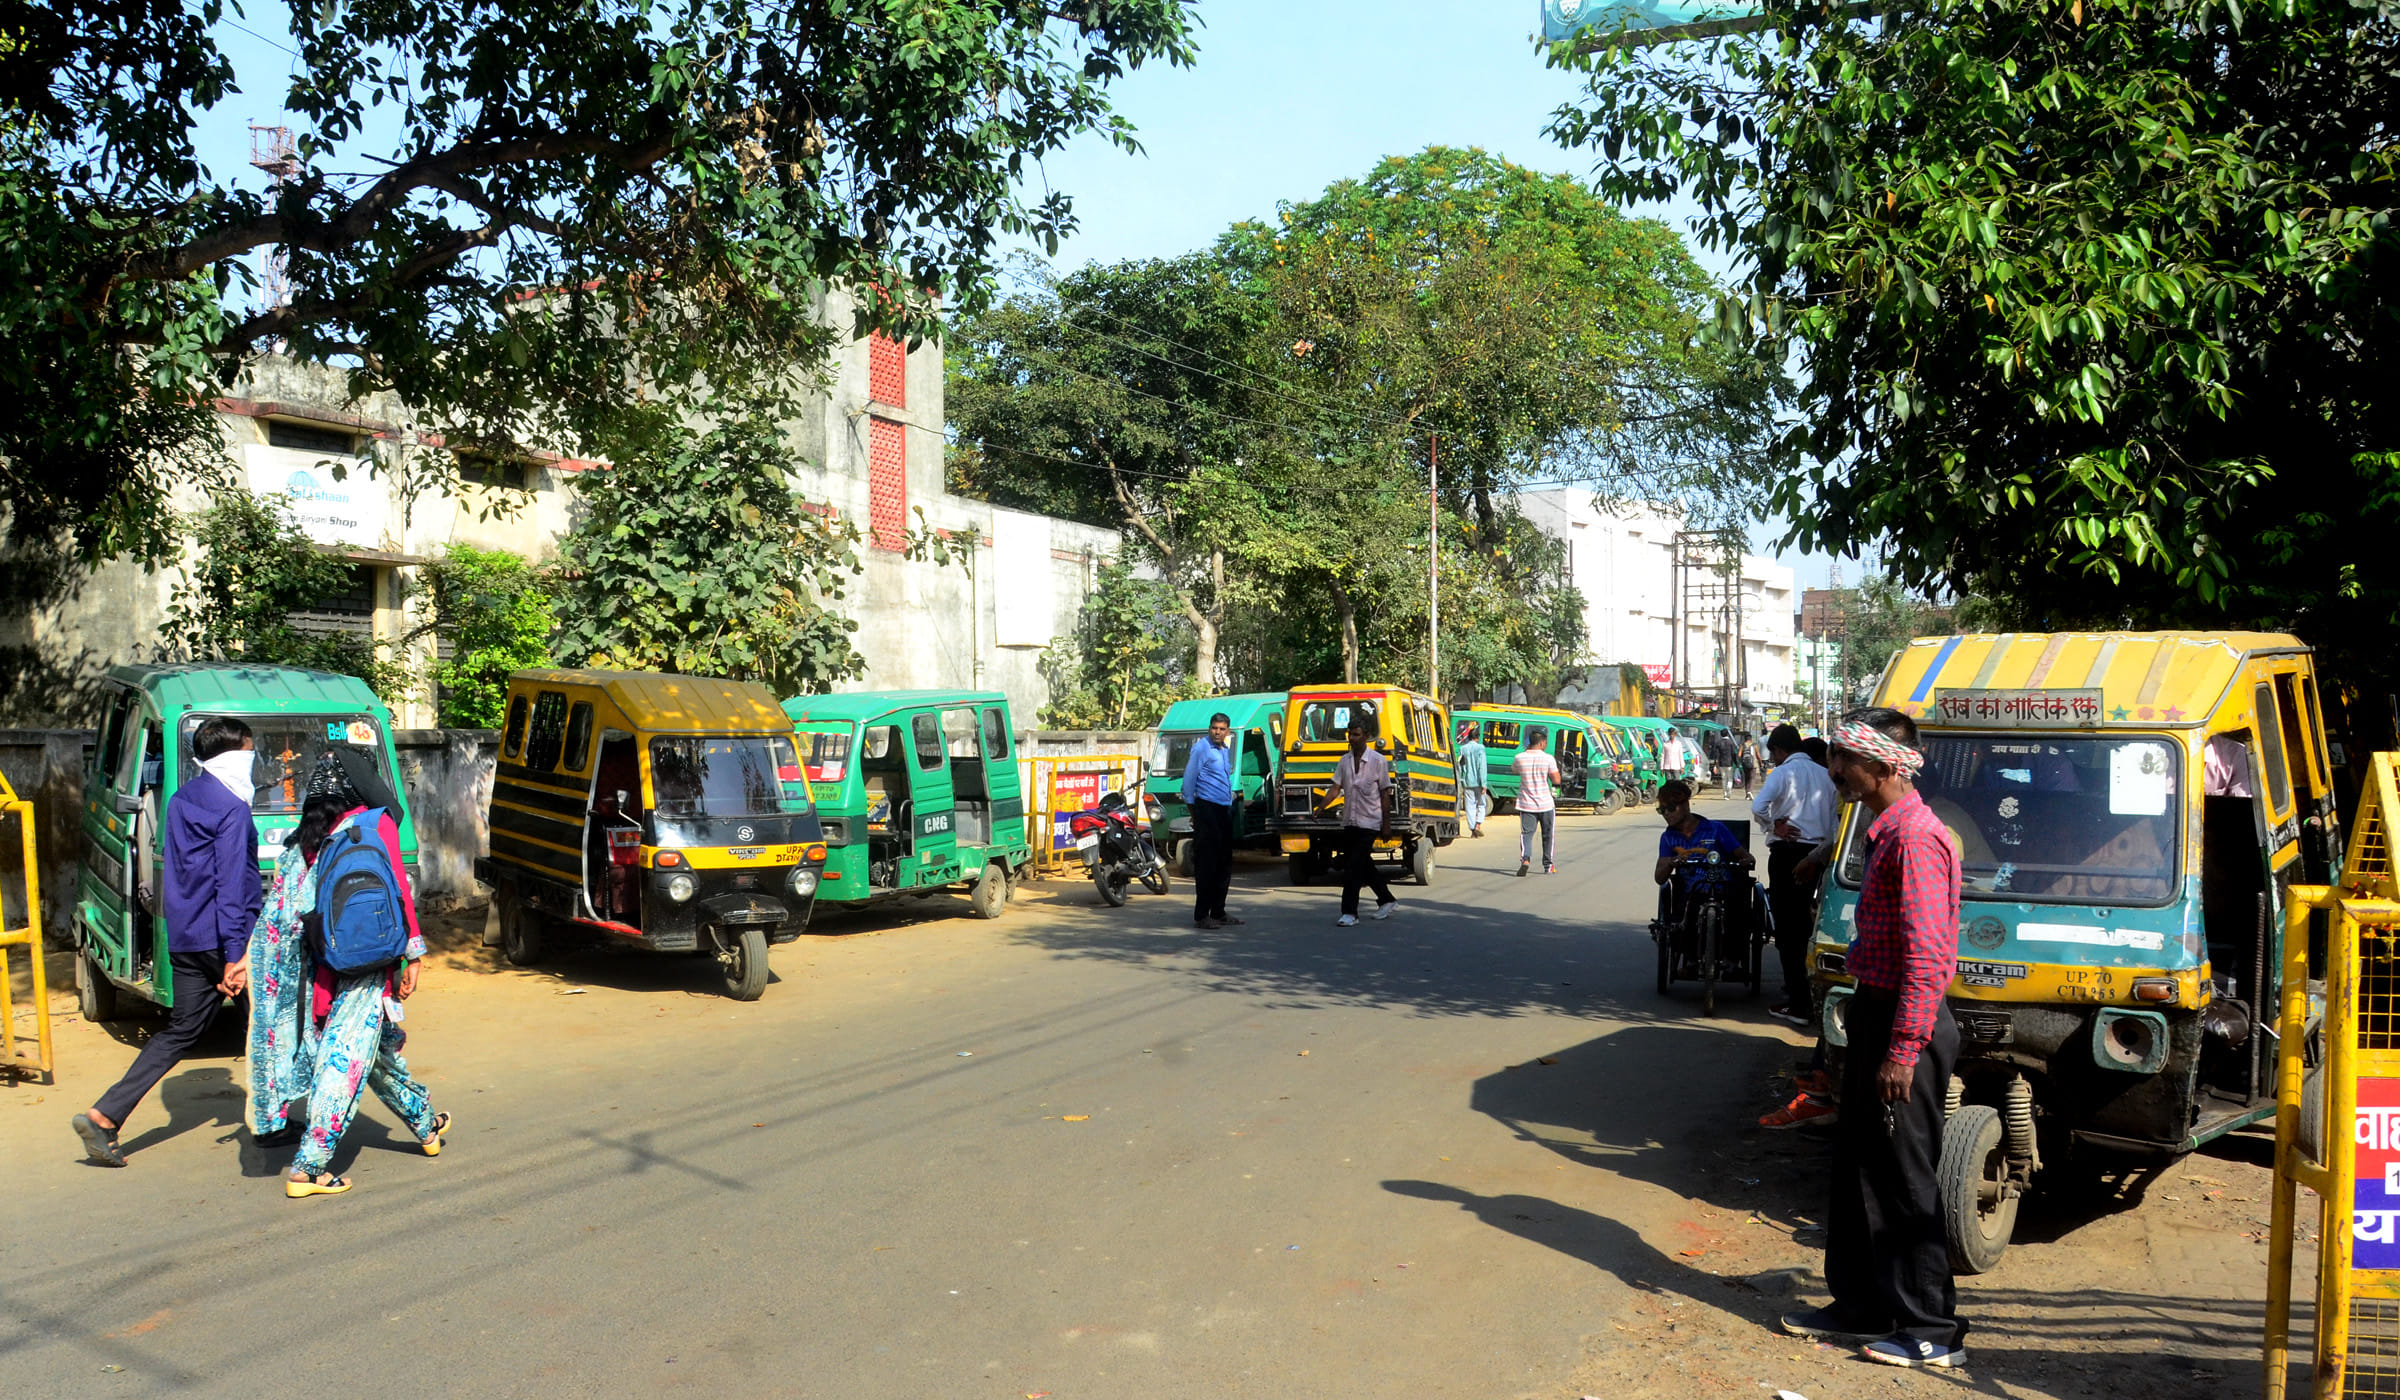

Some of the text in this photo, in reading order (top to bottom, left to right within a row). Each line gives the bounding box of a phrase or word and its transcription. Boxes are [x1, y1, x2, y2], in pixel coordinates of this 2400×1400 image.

[329, 516, 358, 529] Shop
[1938, 697, 1973, 720] सब
[1975, 697, 2002, 720] का
[924, 816, 948, 834] CNG
[1956, 961, 2025, 978] ikram
[2094, 971, 2113, 985] 70
